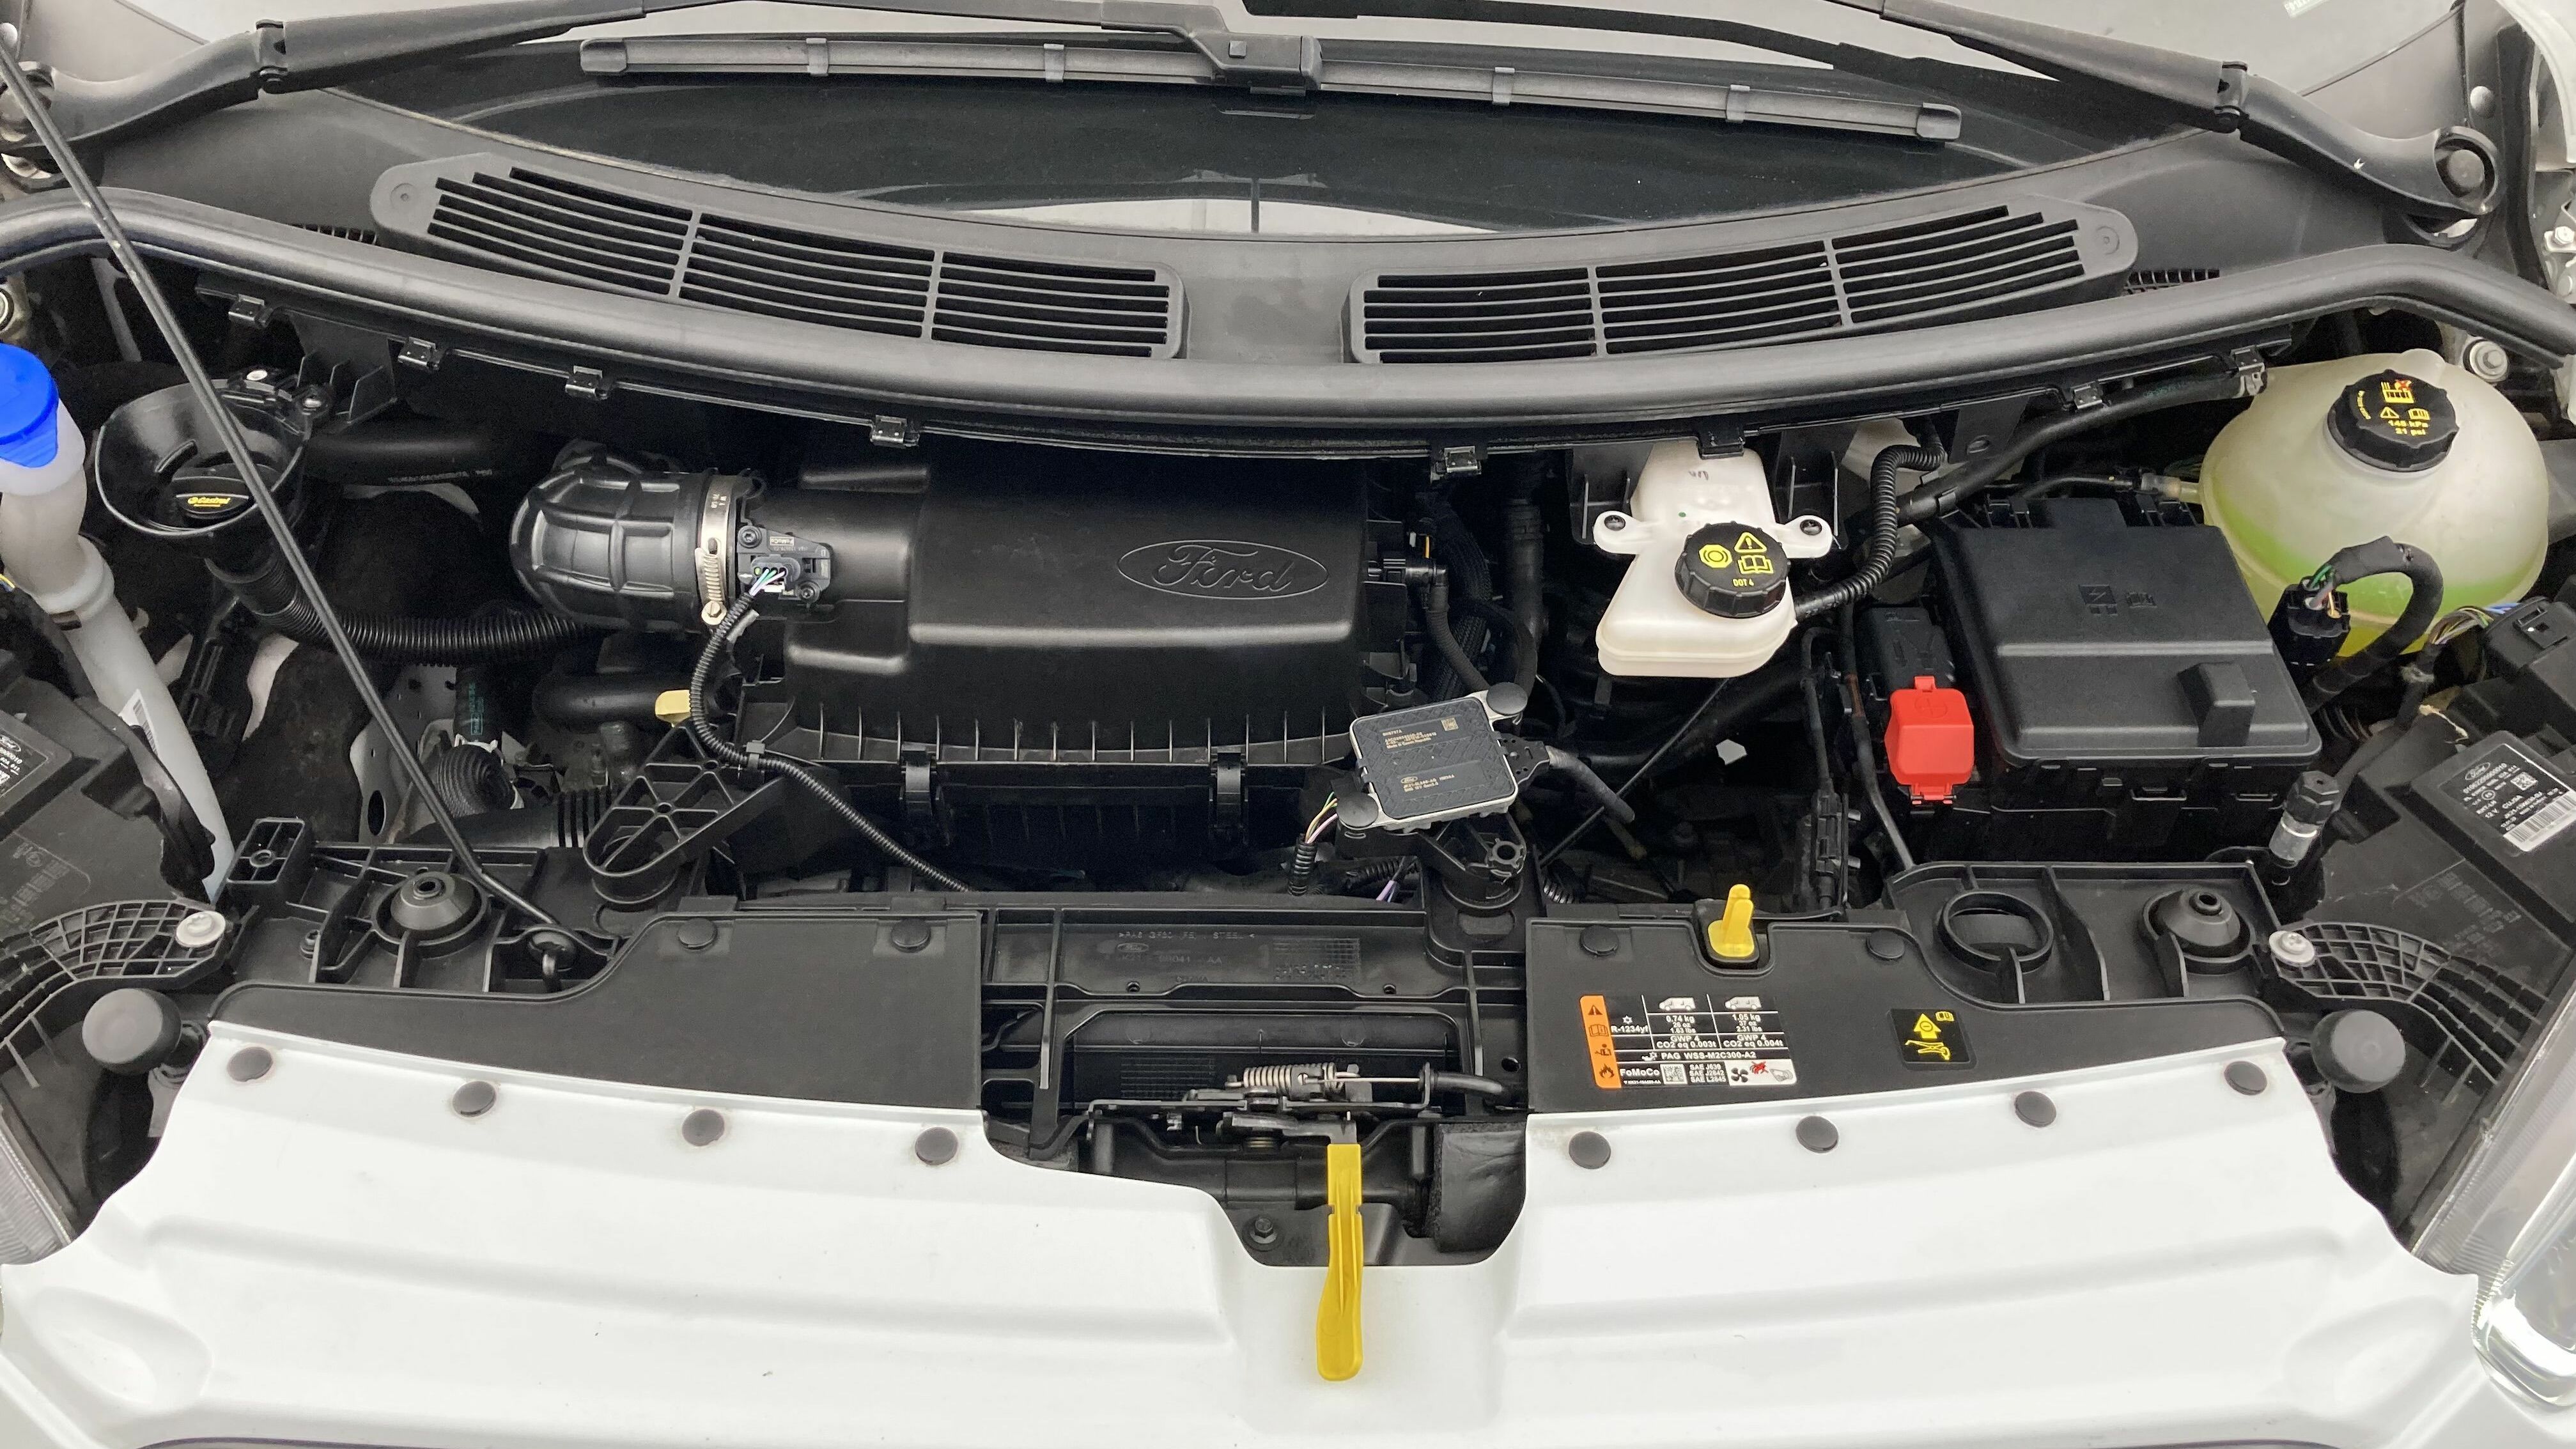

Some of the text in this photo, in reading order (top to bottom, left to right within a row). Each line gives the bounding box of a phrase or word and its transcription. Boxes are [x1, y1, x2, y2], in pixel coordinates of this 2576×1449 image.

[1149, 543, 1298, 593] Ford
[1732, 578, 1747, 587] DOT
[1684, 1015, 1695, 1023] kg
[1750, 1014, 1761, 1022] kg
[1611, 1025, 1649, 1034] R-1234yf
[1684, 1051, 1757, 1060] WSS-M2C300-A2
[1620, 1068, 1660, 1076] FoMoCo
